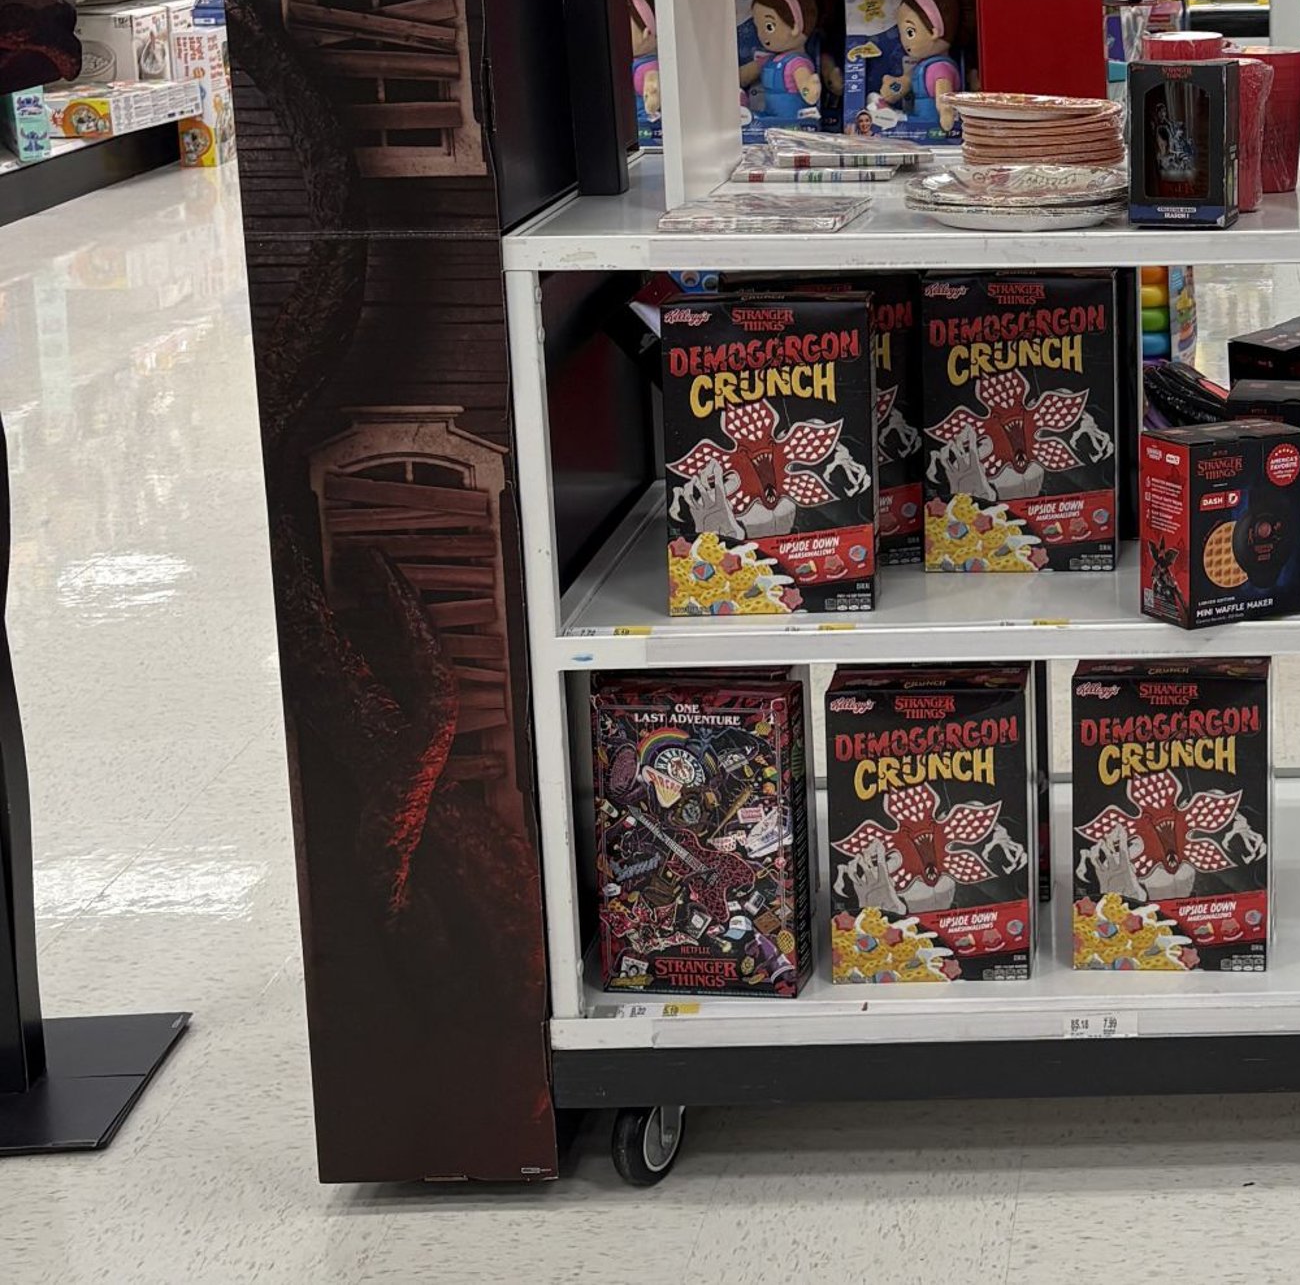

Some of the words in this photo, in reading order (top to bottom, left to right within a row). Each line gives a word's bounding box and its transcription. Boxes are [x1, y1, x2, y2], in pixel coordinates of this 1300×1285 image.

[987, 282, 1045, 298] STRANGER
[997, 293, 1037, 305] THINGS
[731, 307, 794, 323] STRANGER
[742, 318, 786, 331] THINGS
[929, 305, 1106, 347] DEMOGORGON
[669, 329, 861, 377] DEMOGORGON
[948, 334, 1083, 386] CRUNCH
[690, 361, 838, 418] CRUNCH
[1198, 455, 1244, 476] STRANGER
[1205, 469, 1236, 480] THINGS
[1028, 502, 1056, 517] UPSIDE
[1060, 499, 1085, 512] DOWN
[1202, 497, 1223, 506] DASH
[780, 540, 809, 554] UPSIDE
[813, 536, 840, 549] DOWN
[1196, 607, 1213, 618] MINI
[1215, 602, 1245, 614] WAFFLE
[1247, 598, 1274, 609] MAKER
[1139, 682, 1199, 698] STRANGER
[894, 696, 956, 712] STRANGER
[1149, 694, 1190, 706] THINGS
[674, 704, 700, 714] ONE
[904, 708, 947, 720] THINGS
[634, 713, 667, 723] LAST
[669, 714, 742, 726] ADVENTURE
[1080, 705, 1261, 747] DEMOGORGON
[835, 715, 1019, 762] DEMOGORGON
[1098, 734, 1237, 786] CRUNCH
[854, 746, 996, 801] CRUNCH
[1179, 902, 1207, 916] UPSIDE
[1210, 900, 1237, 912] DOWN
[939, 915, 968, 929] UPSIDE
[971, 911, 998, 925] DOWN
[680, 946, 711, 954] NETFLIX
[654, 957, 738, 978] STRANGER
[667, 973, 727, 988] THINGS
